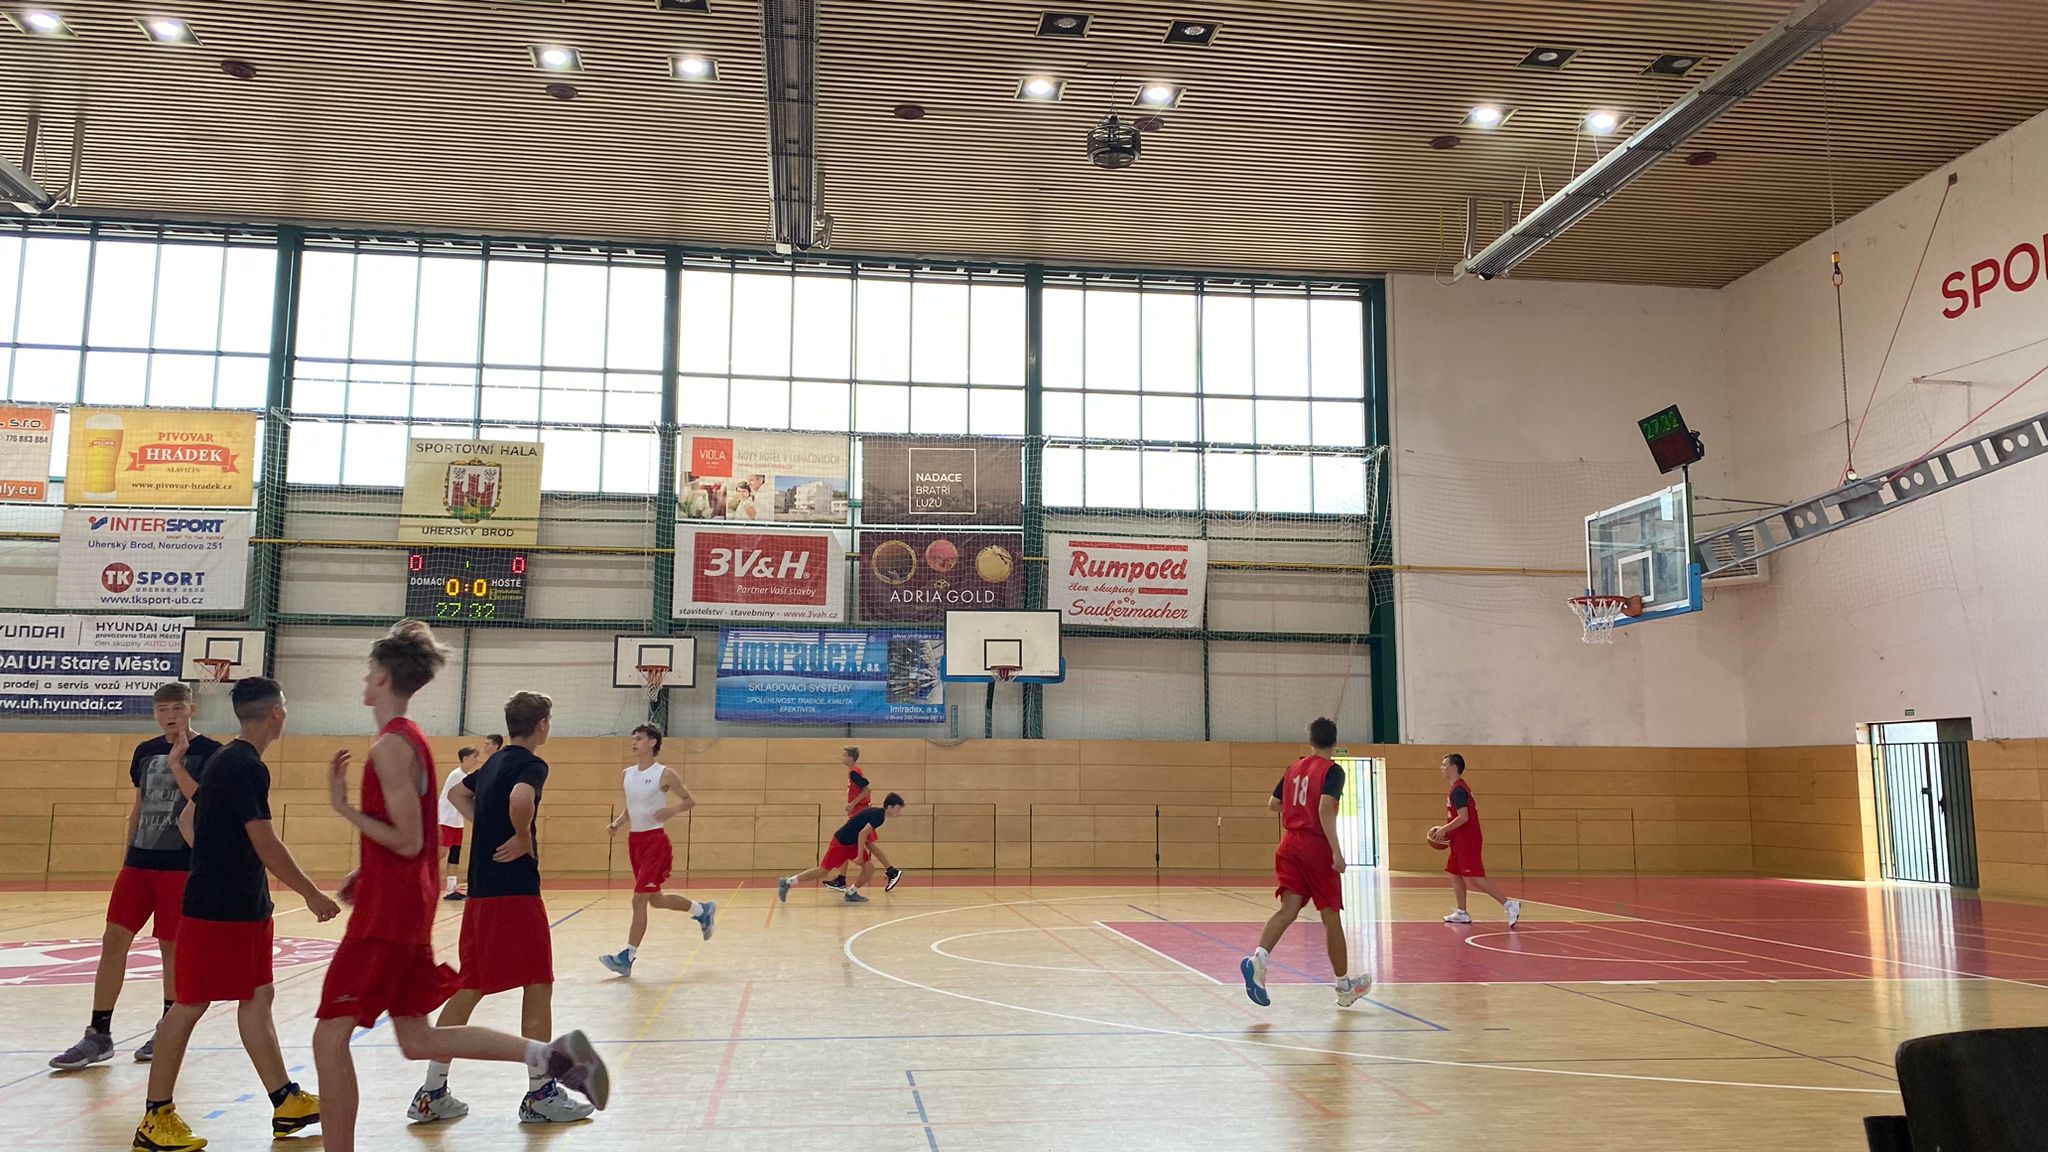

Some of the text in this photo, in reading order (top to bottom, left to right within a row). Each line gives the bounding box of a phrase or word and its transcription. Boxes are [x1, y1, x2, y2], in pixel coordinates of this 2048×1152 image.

[157, 432, 214, 443] PIVOVAR
[146, 445, 223, 463] HRÁDEK
[415, 442, 538, 457] SPORTOVNÍ HALA
[699, 449, 726, 460] VIOLA
[759, 452, 780, 462] HOTEL
[915, 473, 962, 483] NADACE
[0, 482, 37, 497] ly.eu
[131, 481, 233, 491] www.pivovar-hradek.cz
[915, 484, 951, 495] BRATŘÍ
[916, 496, 943, 508] LUŽŮ
[109, 517, 224, 533] INTERSPORT
[481, 528, 515, 538] BROD
[88, 540, 223, 551] Uherský Brod, Nerudova 251
[1068, 550, 1189, 583] Rumpold
[104, 569, 206, 586] TK SPORT
[736, 585, 817, 598] Partner Vaší stavby
[1068, 582, 1135, 595] člen skupiny
[100, 595, 204, 606] www.tksport-ub.cz
[679, 607, 838, 619] stavitelství stavebniny www.3vah.cz
[1068, 598, 1189, 620] Saubermacher
[95, 621, 182, 633] HYUNDAI UH
[112, 640, 142, 648] skupiny
[143, 640, 167, 648] AUTO
[27, 655, 56, 670] UH
[60, 655, 110, 670] Staré
[114, 656, 171, 671] Město
[3, 680, 39, 690] prodej
[44, 681, 52, 689] a
[57, 680, 89, 690] servis
[94, 680, 120, 690] vozů
[1292, 775, 1310, 807] 18
